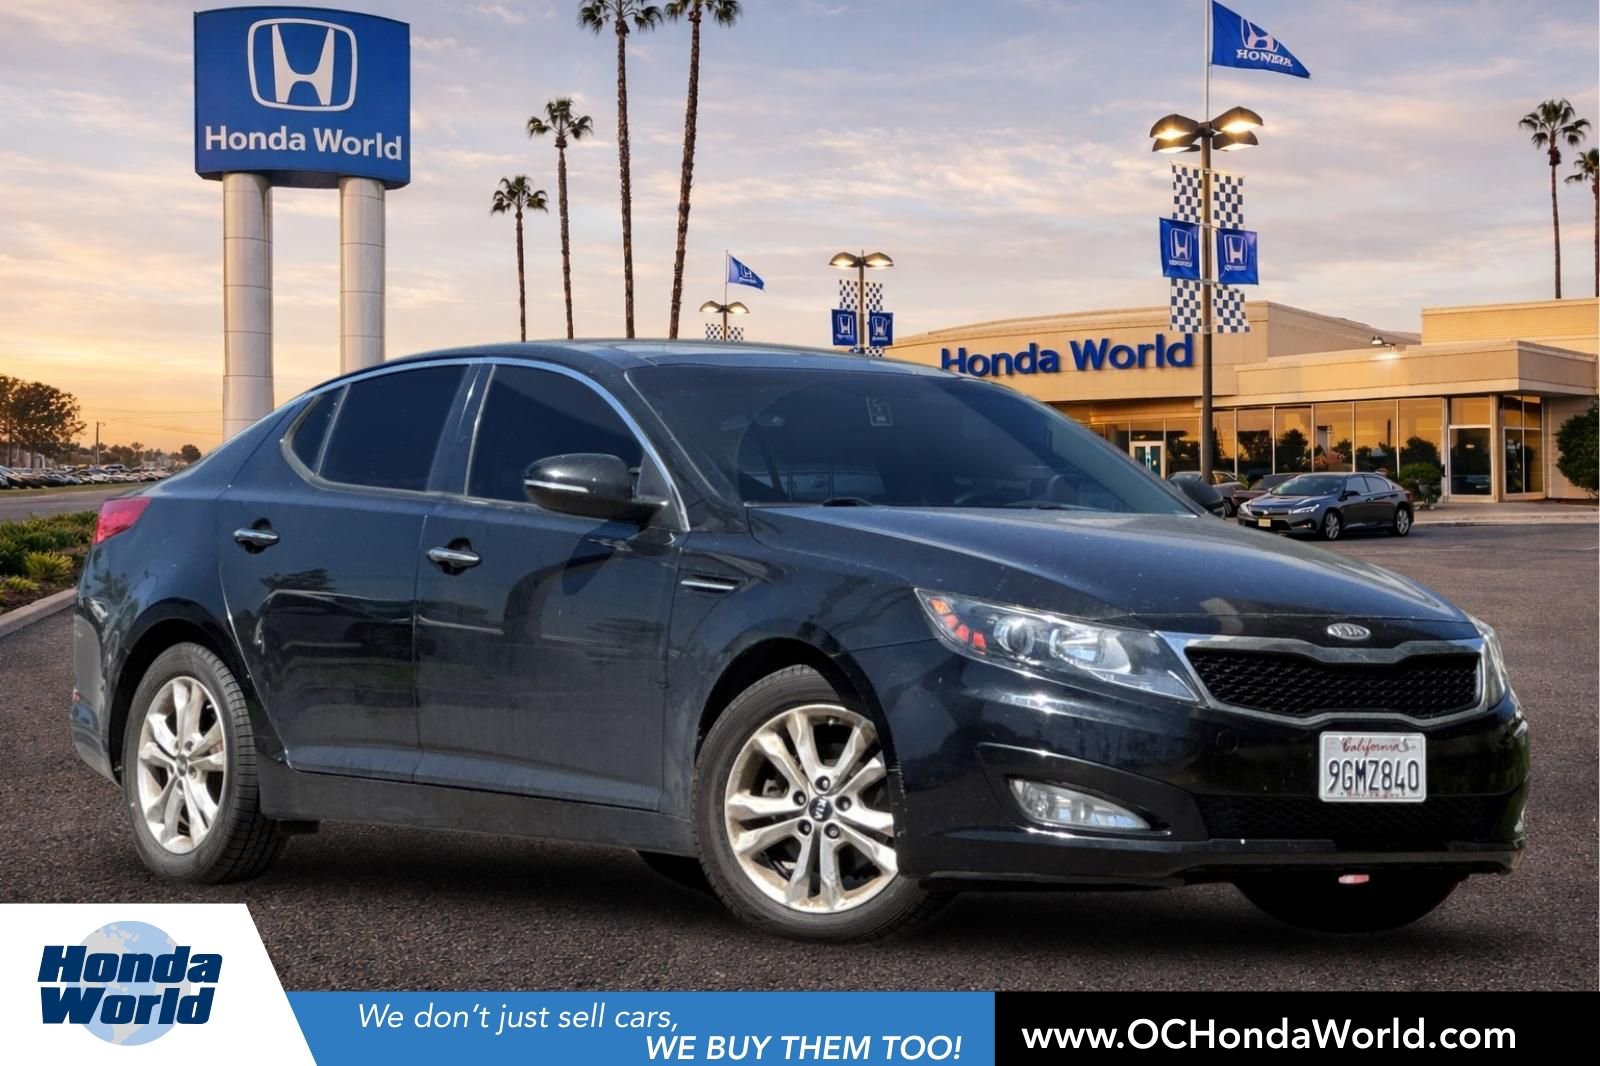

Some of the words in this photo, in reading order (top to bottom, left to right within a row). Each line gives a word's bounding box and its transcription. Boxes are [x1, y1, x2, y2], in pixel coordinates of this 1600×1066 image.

[205, 125, 306, 151] Honda
[312, 127, 402, 160] World
[940, 342, 1061, 378] Honda
[1069, 333, 1195, 371] World
[1328, 759, 1420, 792] 9GMZ840
